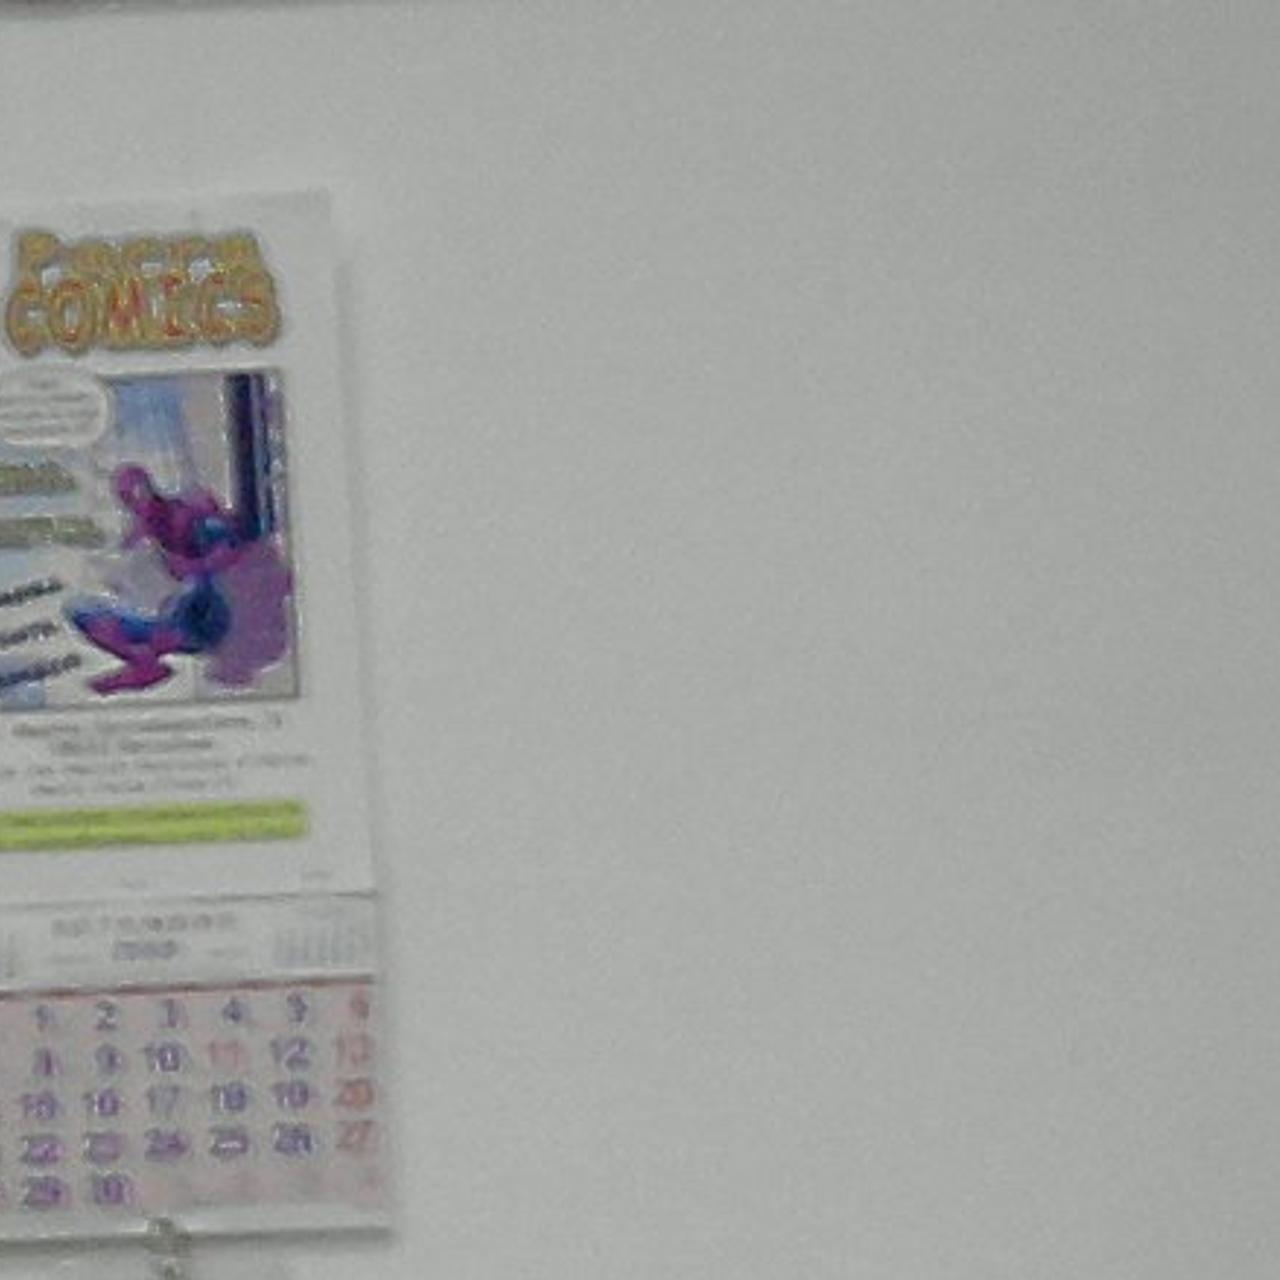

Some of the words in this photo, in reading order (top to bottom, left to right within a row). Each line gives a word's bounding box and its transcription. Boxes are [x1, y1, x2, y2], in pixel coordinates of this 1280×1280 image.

[4, 270, 282, 356] COMICS
[96, 1001, 120, 1033] 2
[143, 1042, 182, 1073] 10
[271, 1036, 313, 1070] 12
